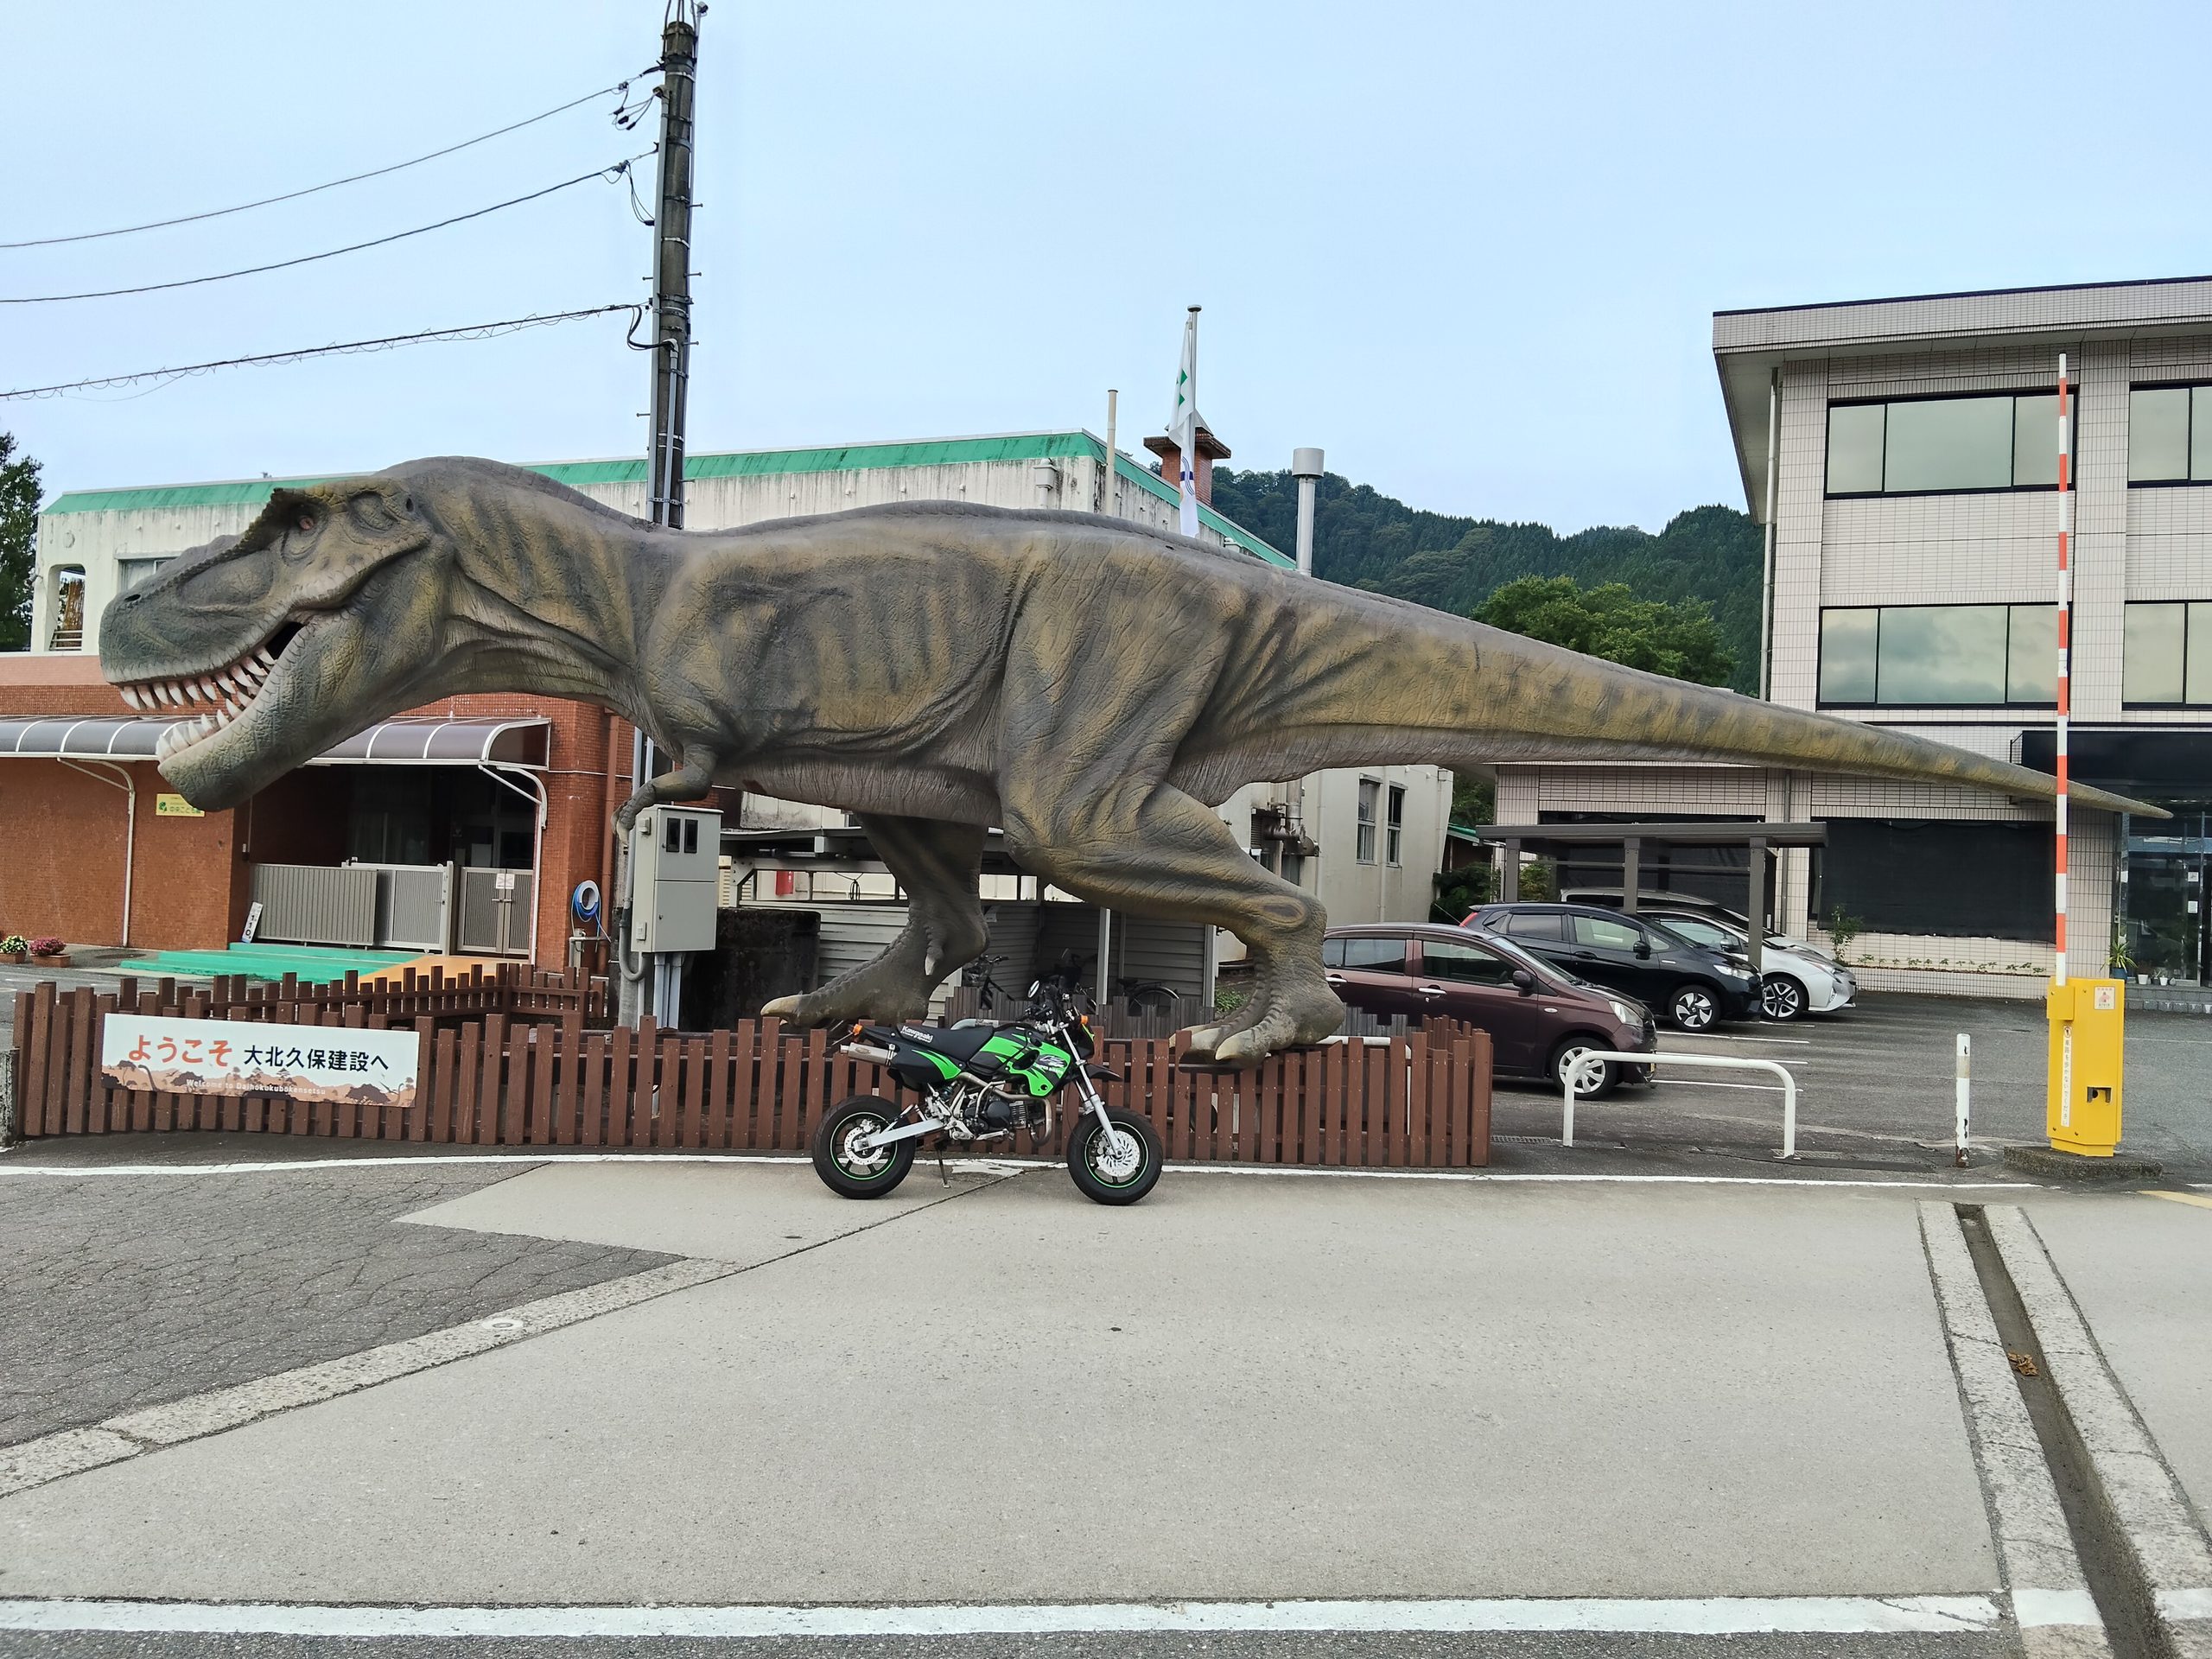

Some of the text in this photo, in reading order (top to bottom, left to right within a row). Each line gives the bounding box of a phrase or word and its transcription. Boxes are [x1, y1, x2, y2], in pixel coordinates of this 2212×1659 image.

[128, 1034, 390, 1072] ようこそ 大北久保建設へ
[186, 1078, 222, 1089] Welcome
